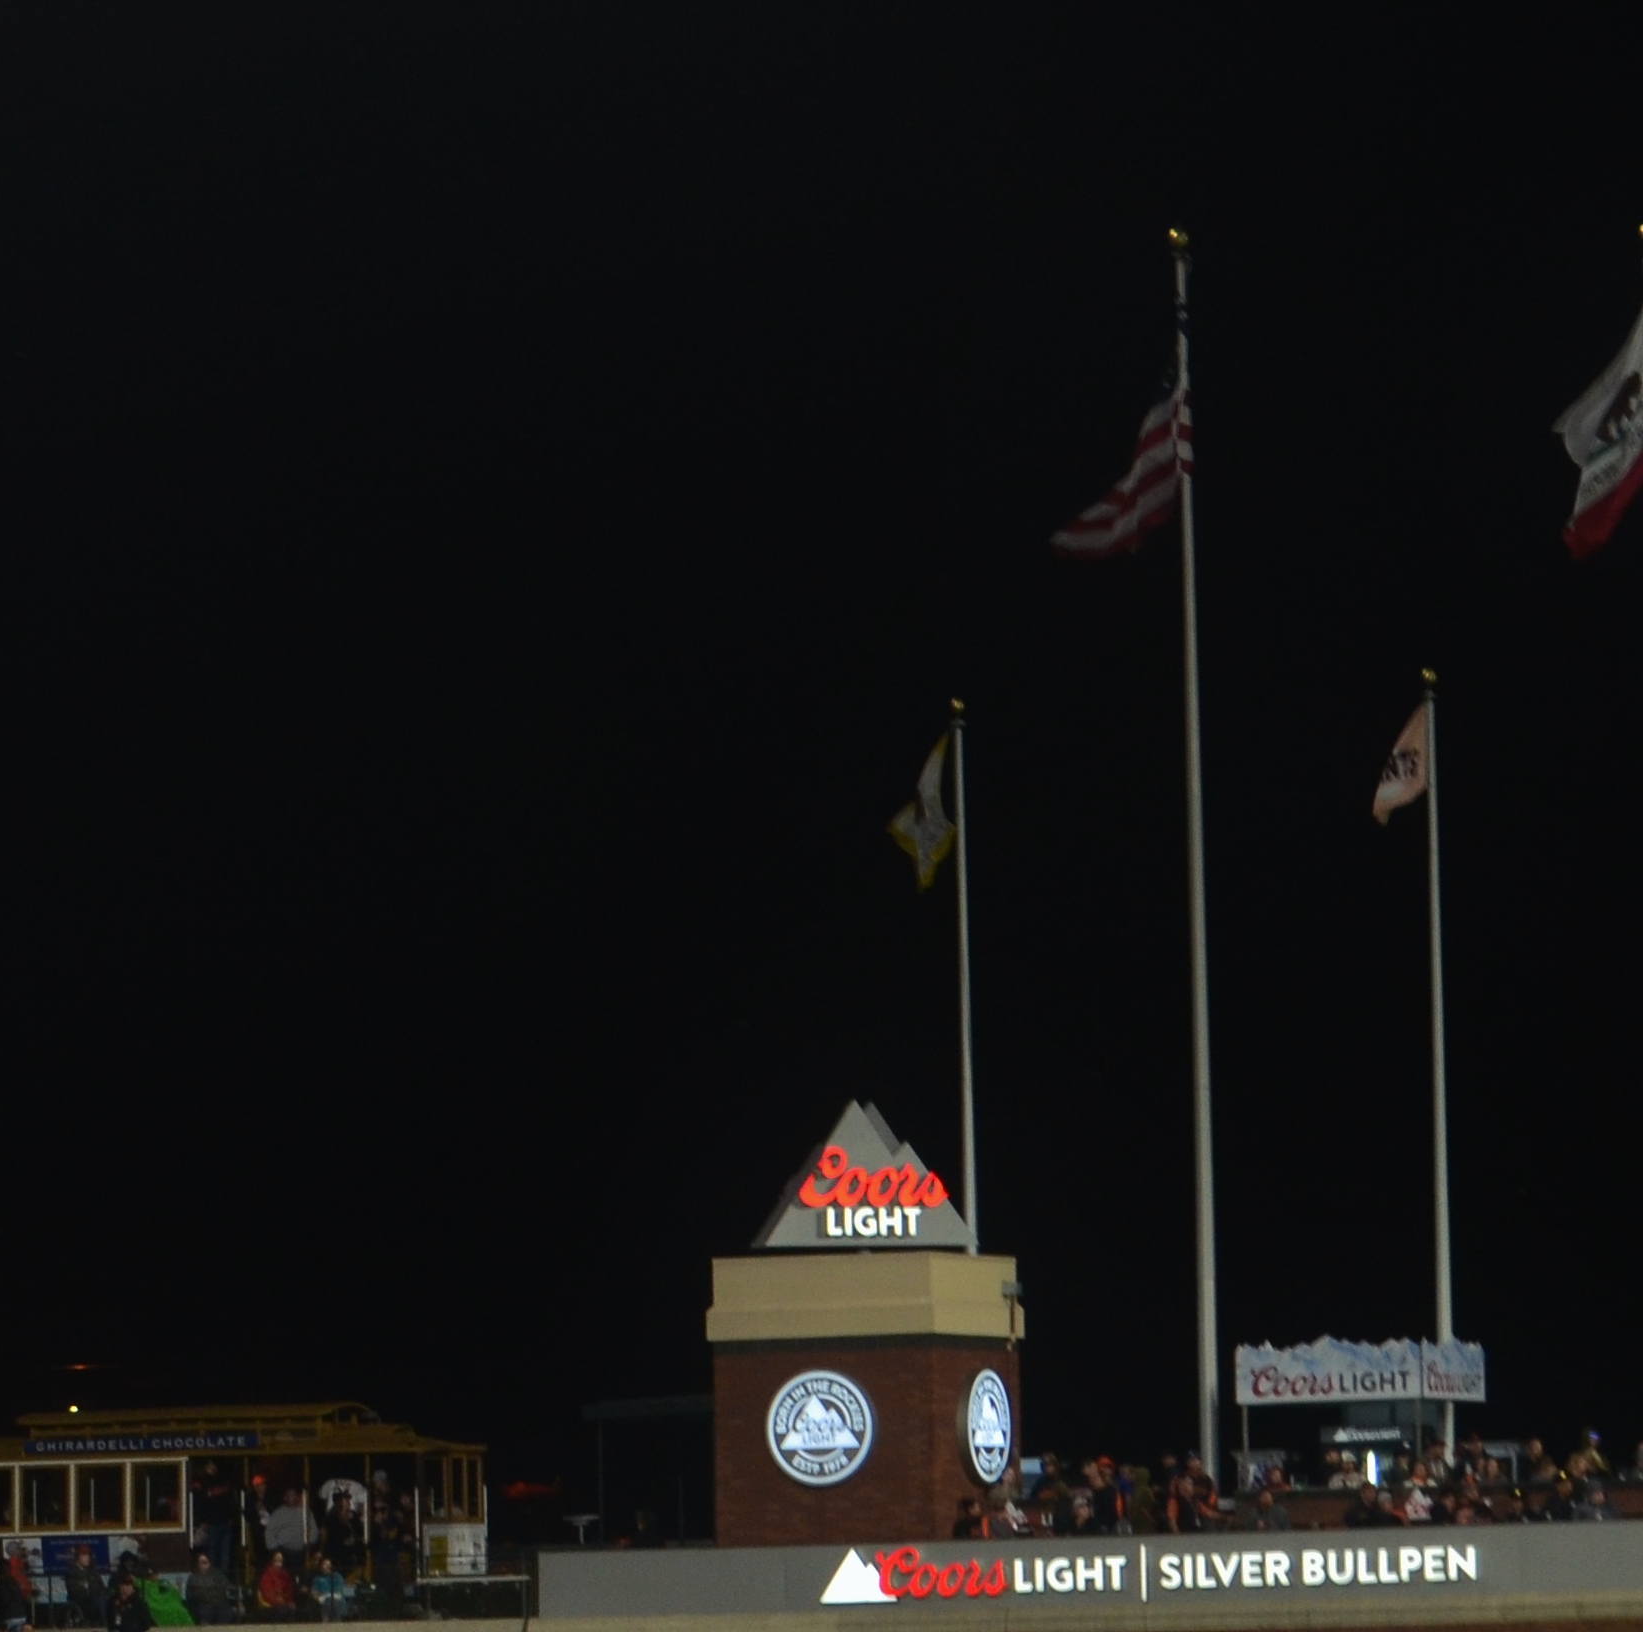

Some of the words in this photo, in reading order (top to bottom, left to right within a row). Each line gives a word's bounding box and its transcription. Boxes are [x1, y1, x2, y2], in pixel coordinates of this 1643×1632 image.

[798, 1145, 949, 1208] Coors
[826, 1205, 922, 1237] LIGHT
[1250, 1365, 1334, 1399] Coors
[1339, 1370, 1411, 1394] LIGHT
[776, 1394, 794, 1434] BORN
[805, 1379, 830, 1393] THE
[35, 1439, 145, 1453] GHIRARDELLI
[151, 1435, 246, 1448] CHOCOLATE
[877, 1546, 1008, 1598] Coors
[1013, 1556, 1126, 1594] LIGHT
[1159, 1551, 1291, 1590] SILVER
[1302, 1544, 1477, 1586] BULLPEN
